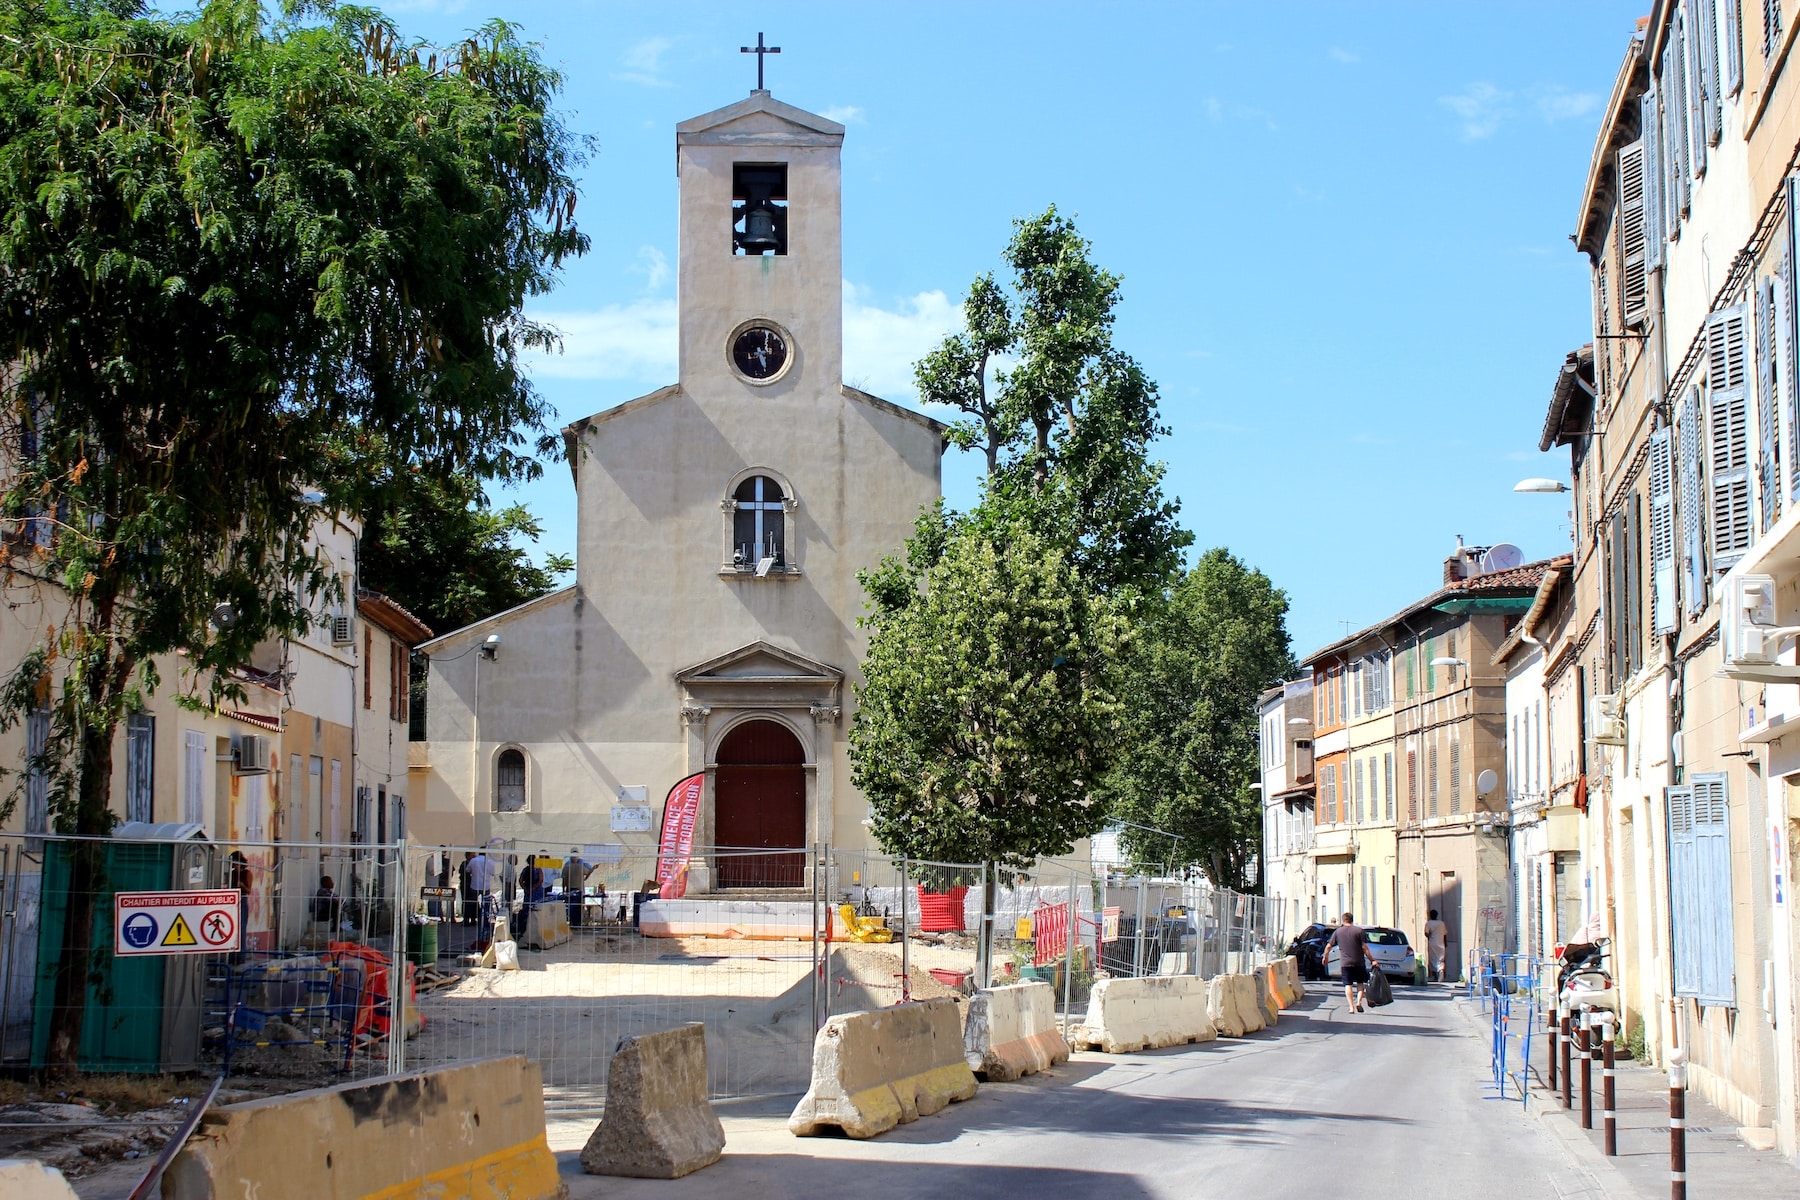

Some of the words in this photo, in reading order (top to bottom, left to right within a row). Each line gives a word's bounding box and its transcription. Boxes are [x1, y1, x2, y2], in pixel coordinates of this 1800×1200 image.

[660, 804, 682, 879] PERMANENCE
[122, 898, 161, 907] CHANTIER
[162, 897, 195, 906] INTERDIT
[197, 897, 207, 905] AU
[208, 896, 235, 904] PUBLIC
